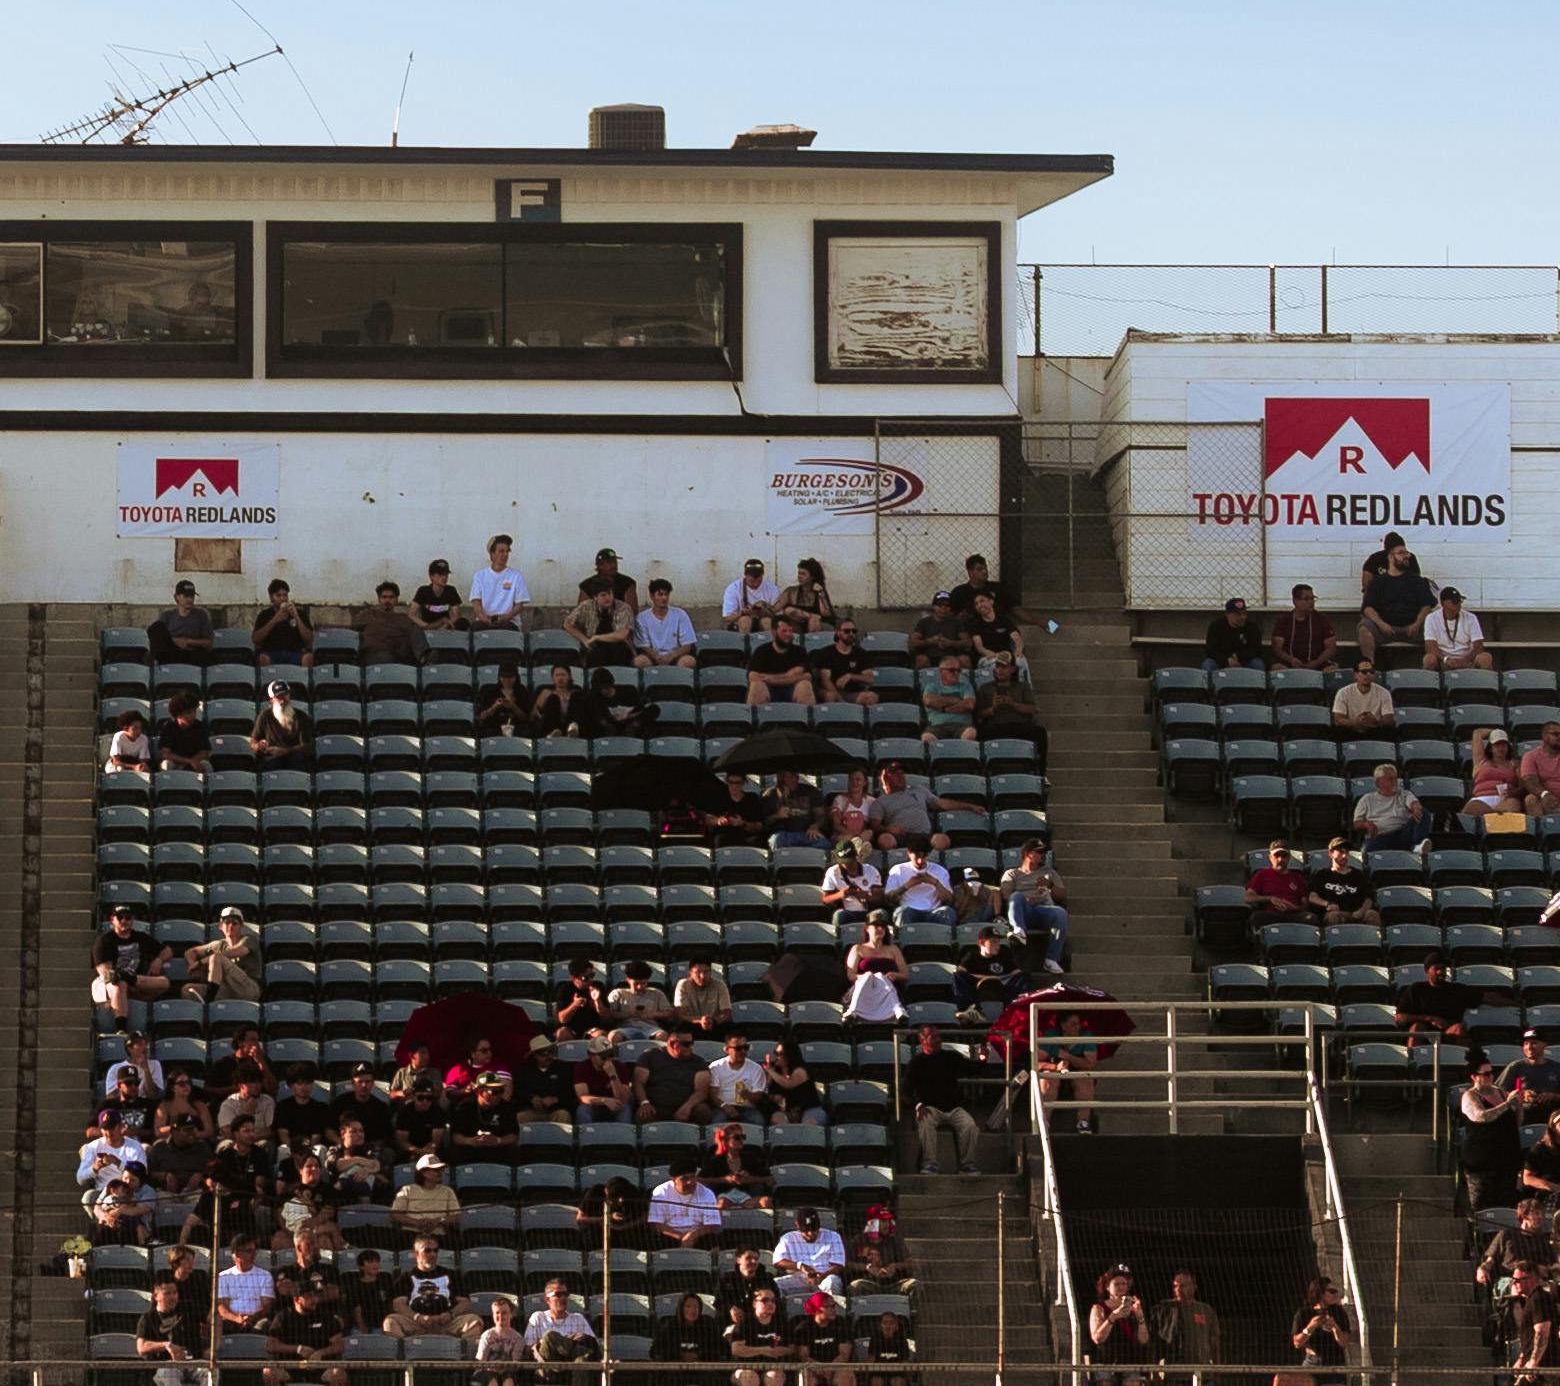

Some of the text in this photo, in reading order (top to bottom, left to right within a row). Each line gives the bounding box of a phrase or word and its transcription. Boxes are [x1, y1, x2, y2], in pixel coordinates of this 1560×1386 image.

[511, 182, 548, 218] F
[1339, 446, 1367, 474] R
[770, 474, 893, 489] BURGESONS
[192, 483, 207, 497] R
[776, 490, 811, 498] HEATING
[834, 490, 881, 499] ELECTRICA
[793, 498, 818, 506] SOLAR
[119, 506, 276, 524] TOYOTA REDLANDS
[1192, 494, 1506, 527] TOYOTA REDLANDS
